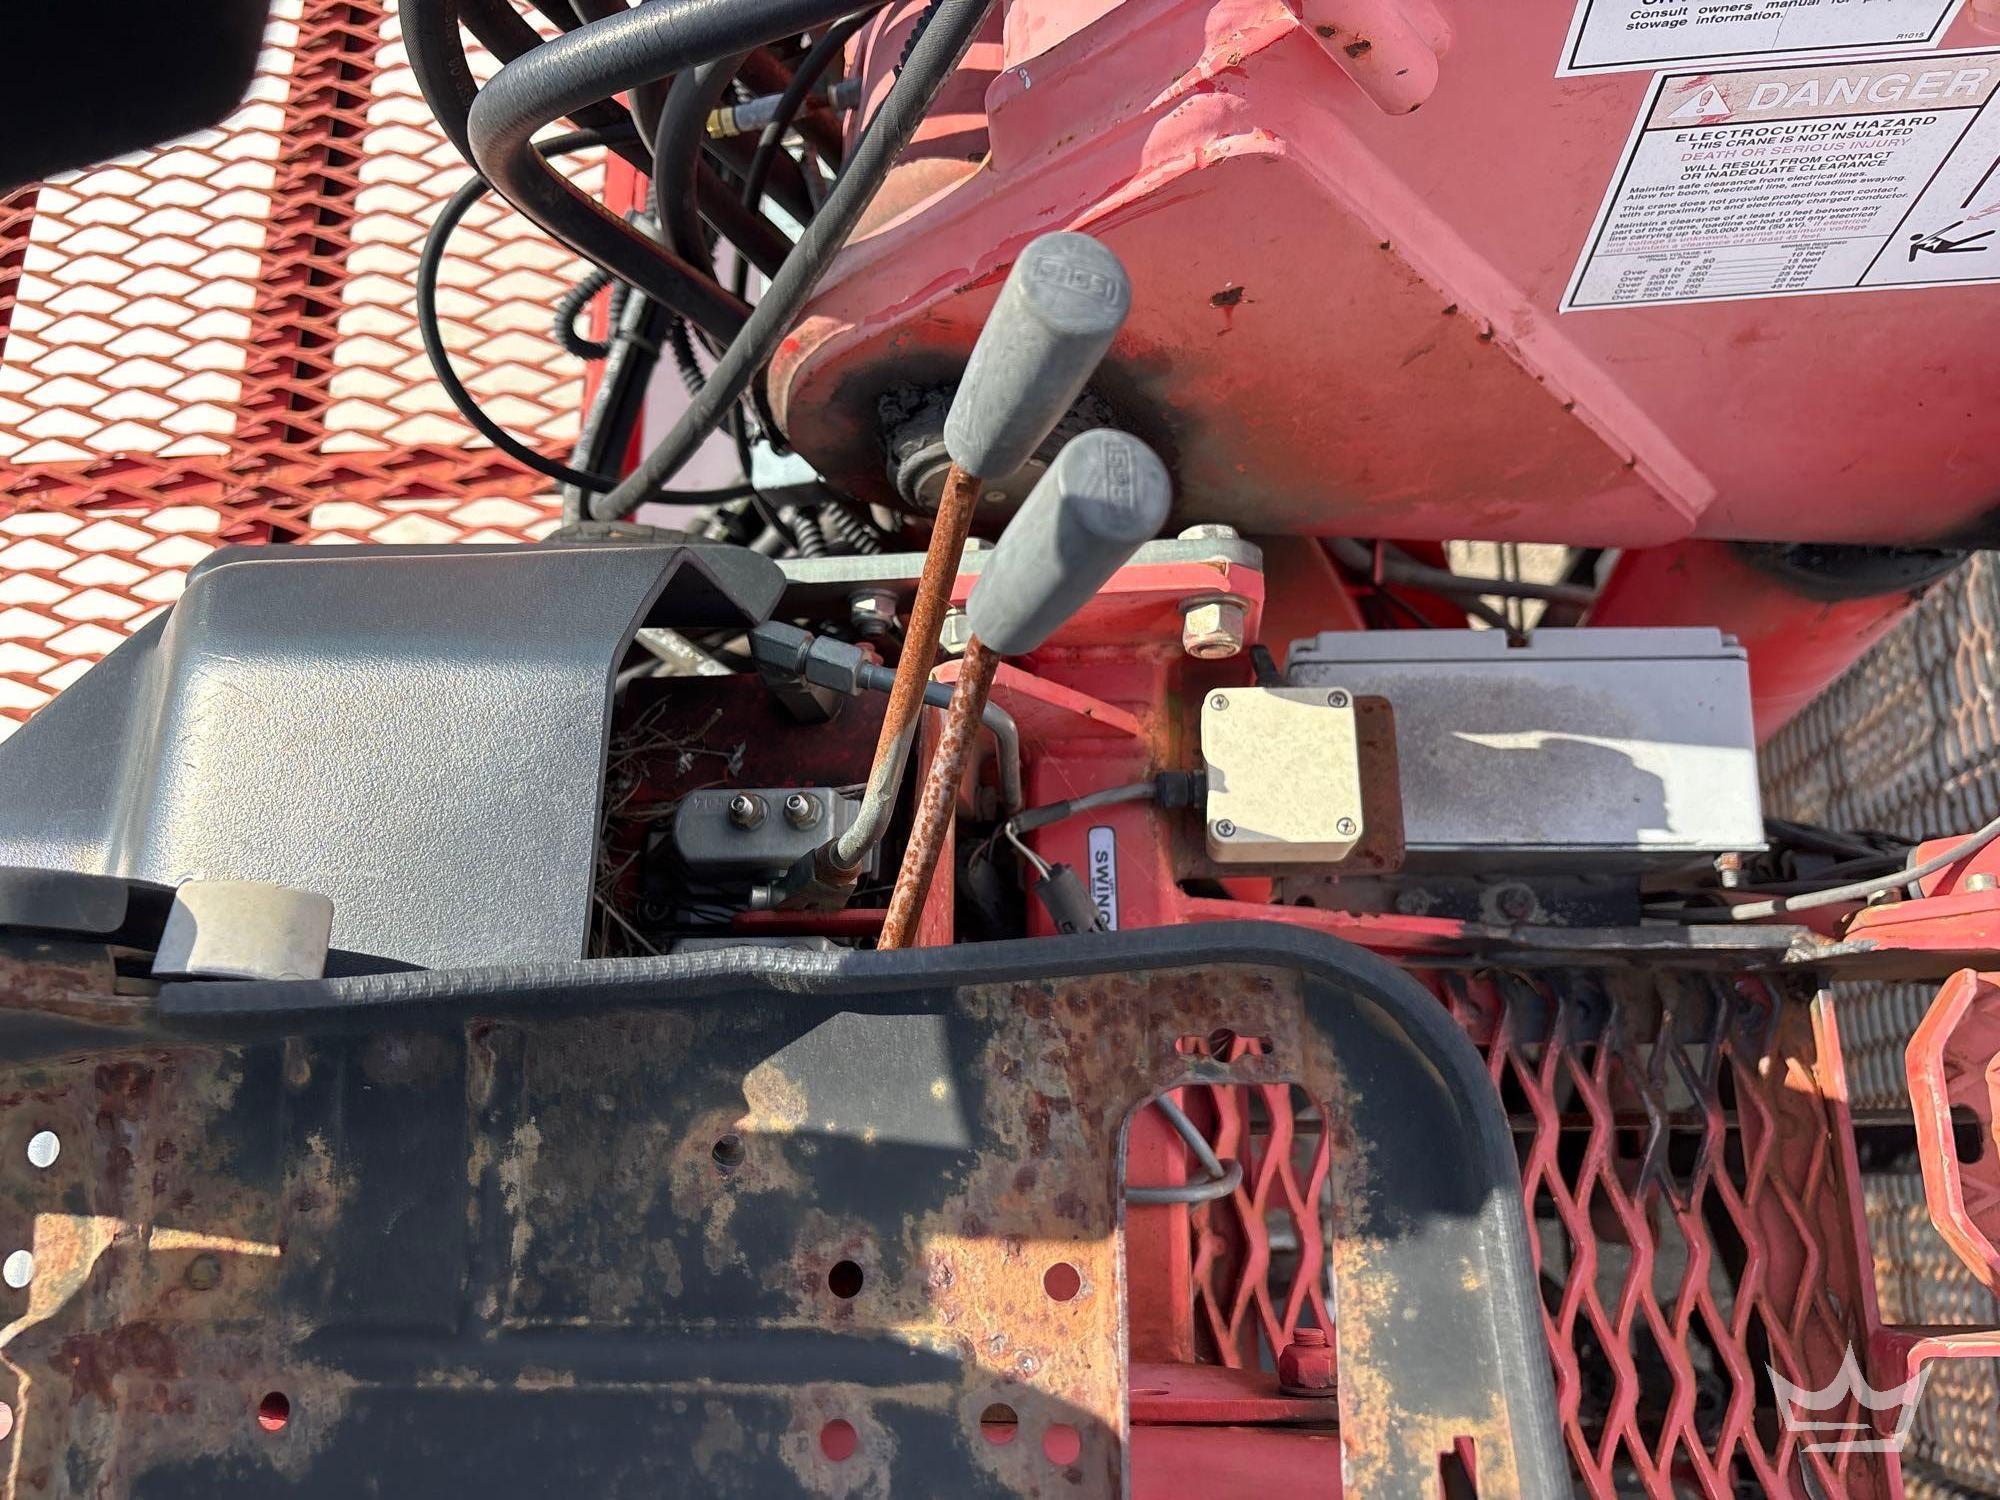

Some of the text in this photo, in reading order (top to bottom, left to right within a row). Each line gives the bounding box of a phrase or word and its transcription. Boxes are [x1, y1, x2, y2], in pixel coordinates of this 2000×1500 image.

[1626, 10, 1783, 30] stowage information.
[1630, 7, 1688, 19] Consult
[1698, 3, 1753, 14] owners
[1747, 67, 1990, 111] DANGER
[1675, 116, 1937, 142] ELECTROCUTION HAZARD
[1690, 128, 1913, 150] THIS CRANE IS NOT INSULATED
[1680, 138, 1911, 161] DEATH OR SERIOUS INJURY
[1684, 151, 1894, 172] WILL RESULT FROM CONTACT
[1705, 165, 1796, 178] INADEQUATE
[1800, 160, 1888, 172] CLEARANCE
[1630, 184, 1675, 193] Maintain
[1678, 182, 1700, 190] safe
[1704, 179, 1756, 188] clearance
[1788, 174, 1837, 182] electrical
[1714, 184, 1763, 193] electrical
[1728, 195, 1769, 205] provide
[1772, 190, 1827, 201] protection
[1857, 186, 1898, 194] contact
[1807, 196, 1851, 205] charged
